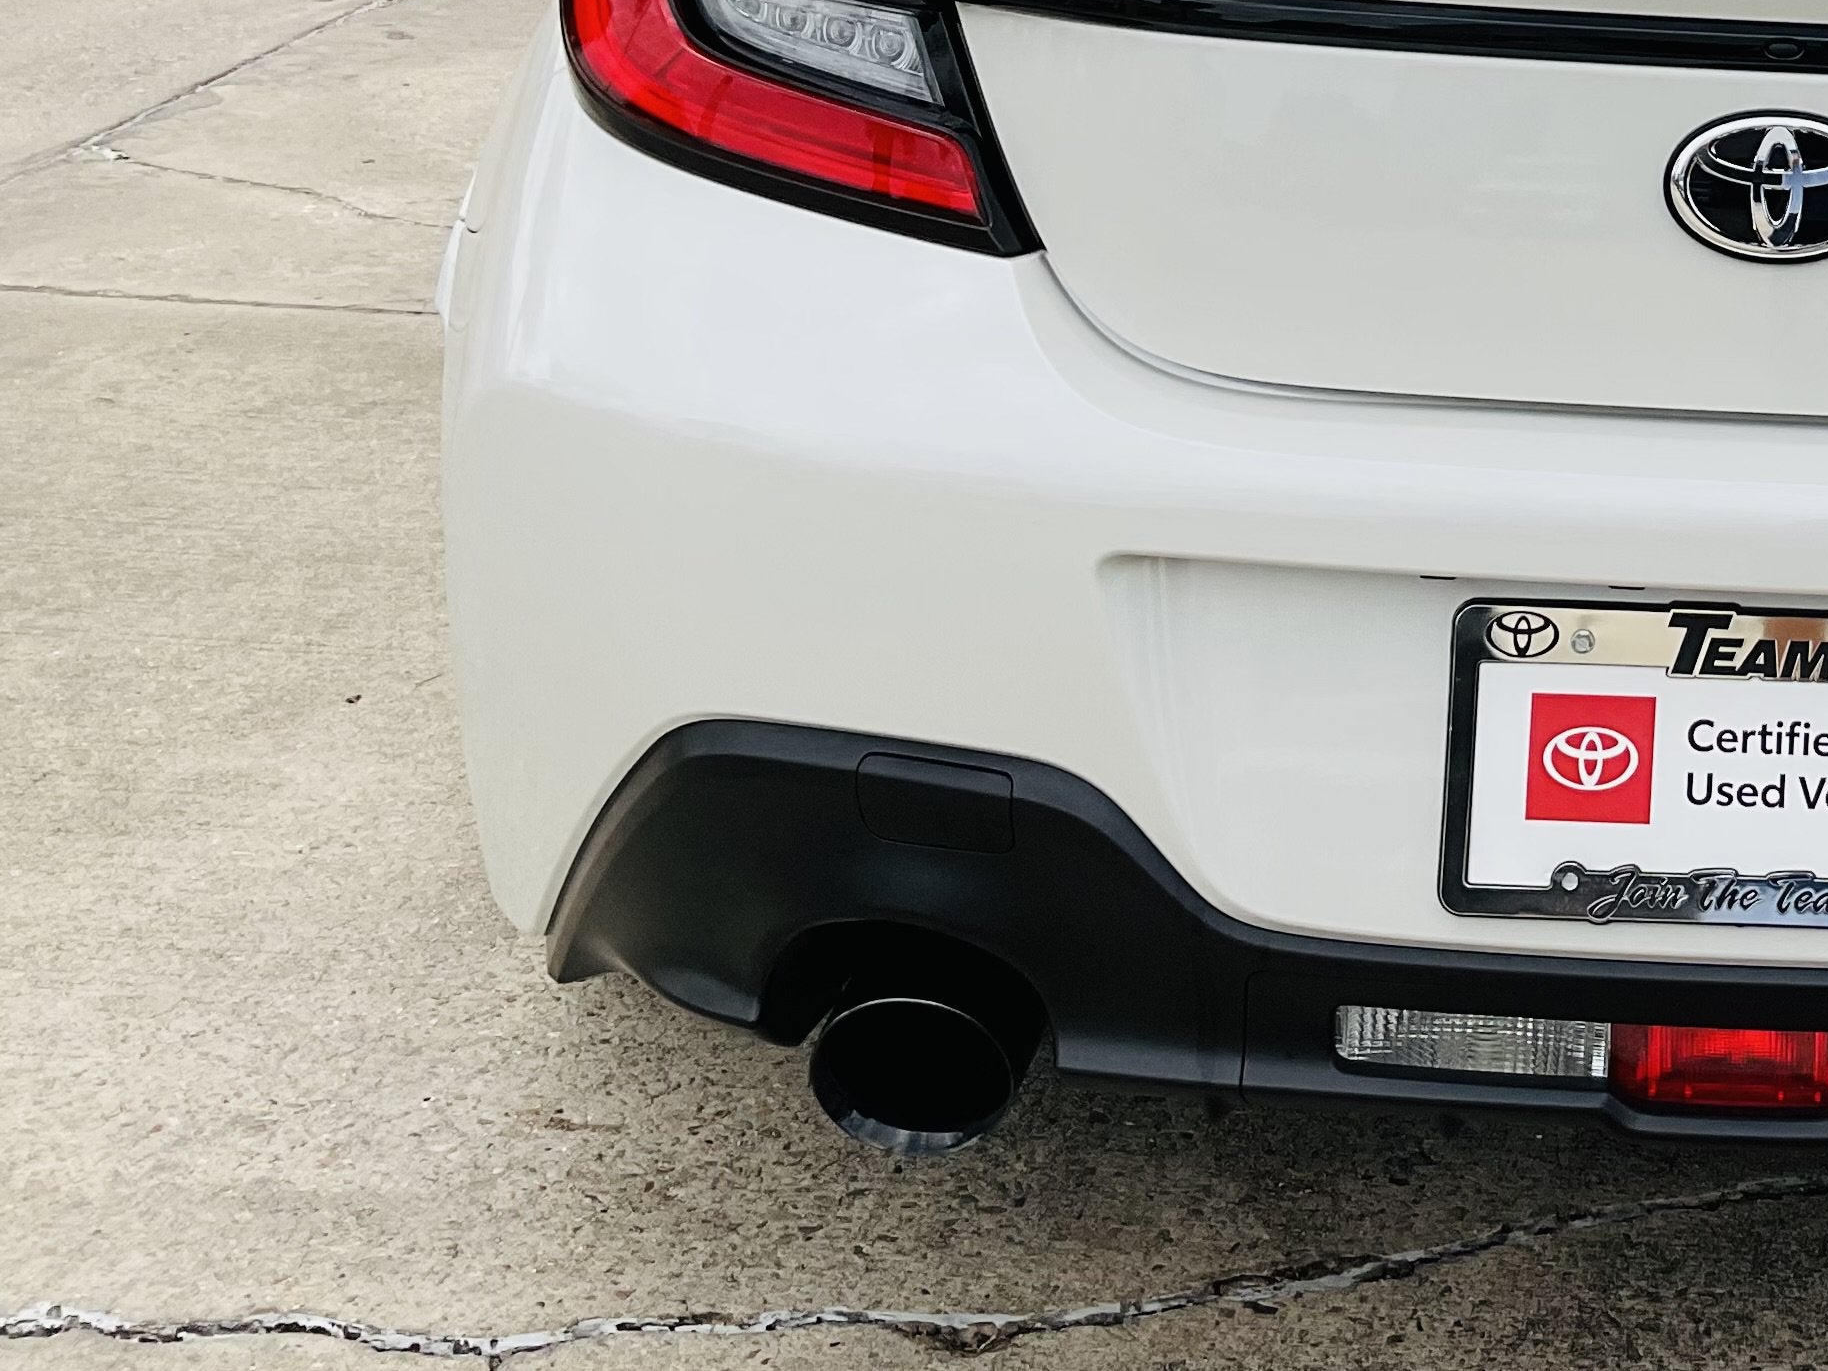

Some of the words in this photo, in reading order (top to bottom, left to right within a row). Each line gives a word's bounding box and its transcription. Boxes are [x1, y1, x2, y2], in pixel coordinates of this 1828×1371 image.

[1686, 772, 1785, 808] Used
[1586, 863, 1688, 921] Join
[1690, 868, 1761, 914] The
